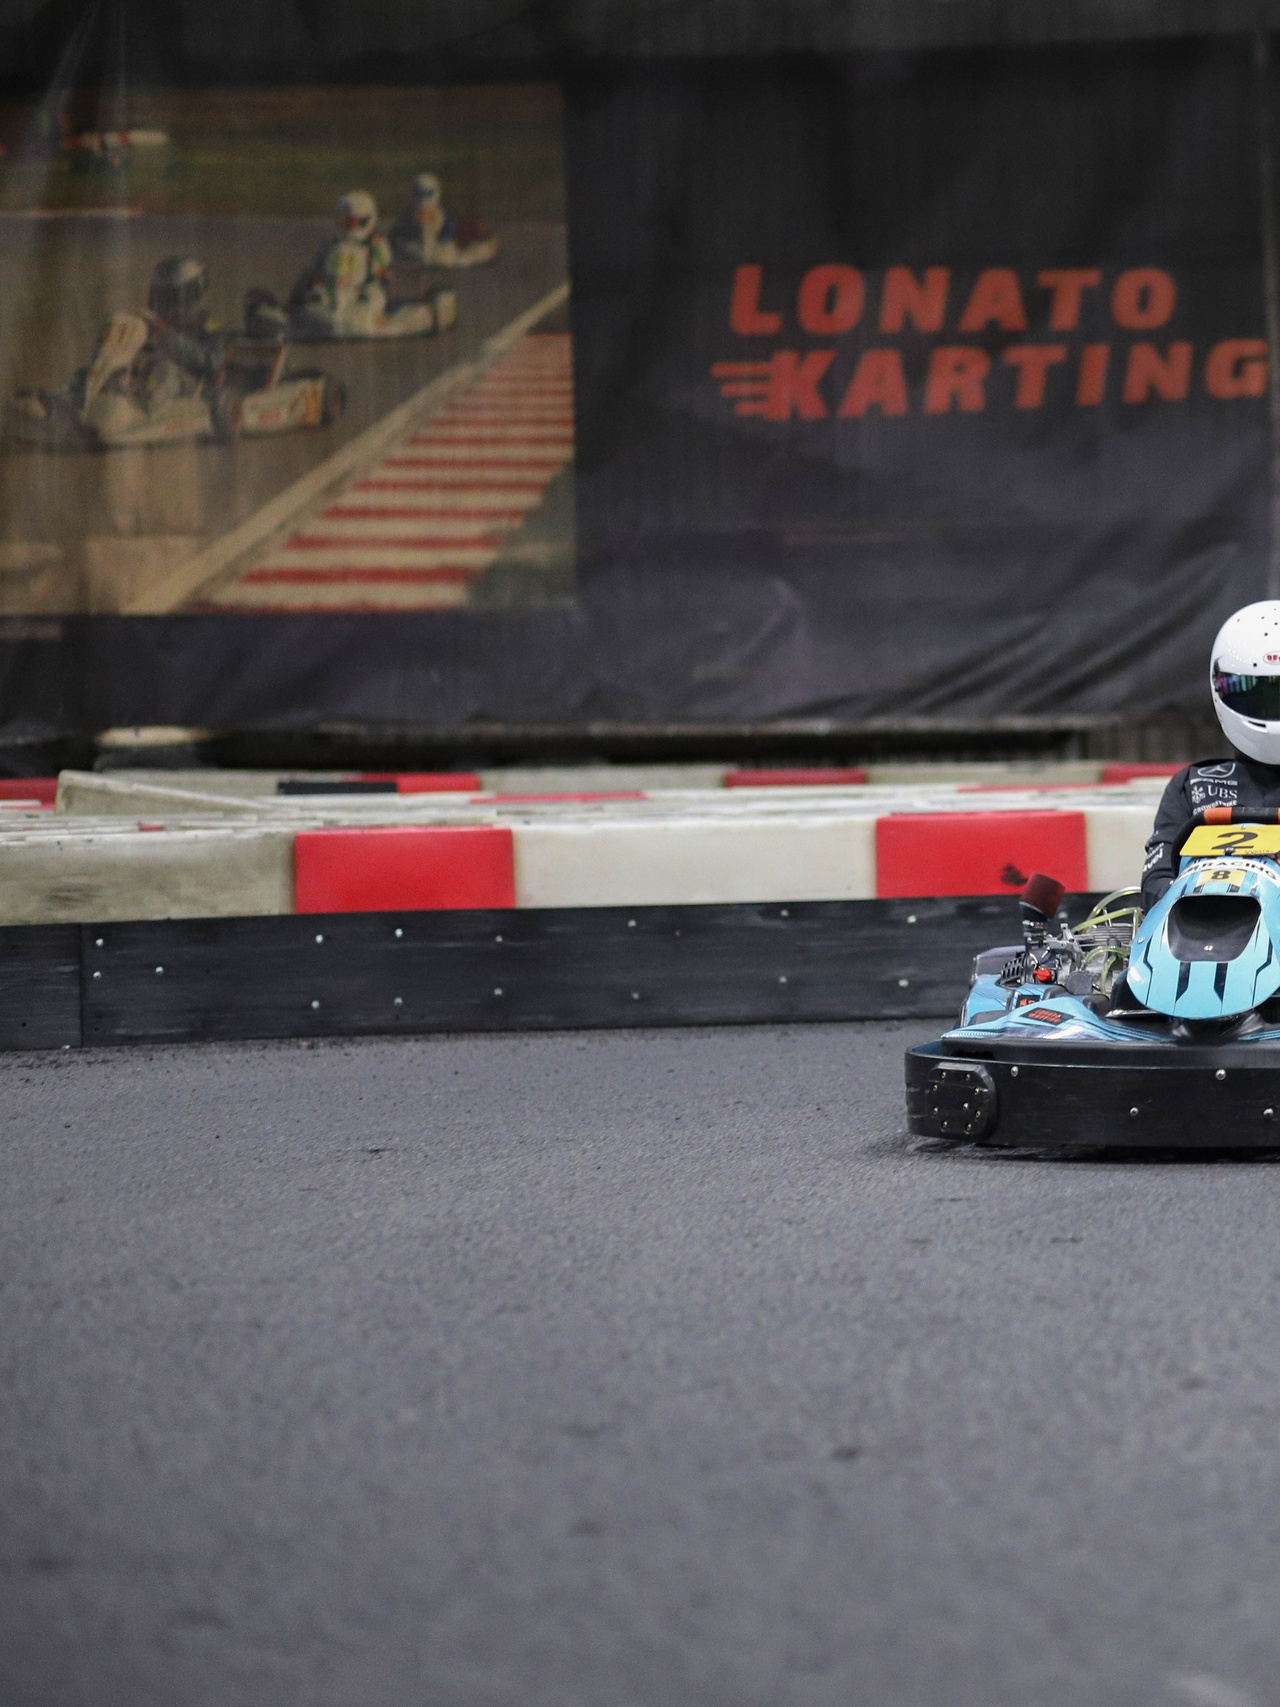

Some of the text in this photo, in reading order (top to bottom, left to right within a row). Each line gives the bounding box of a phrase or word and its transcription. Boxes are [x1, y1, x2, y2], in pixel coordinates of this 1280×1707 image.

[729, 263, 1177, 335] LONATO
[763, 338, 1268, 421] KARTING
[1207, 785, 1238, 799] UBS
[1211, 831, 1258, 850] 2
[1201, 861, 1277, 881] RACING
[1211, 870, 1231, 880] 8
